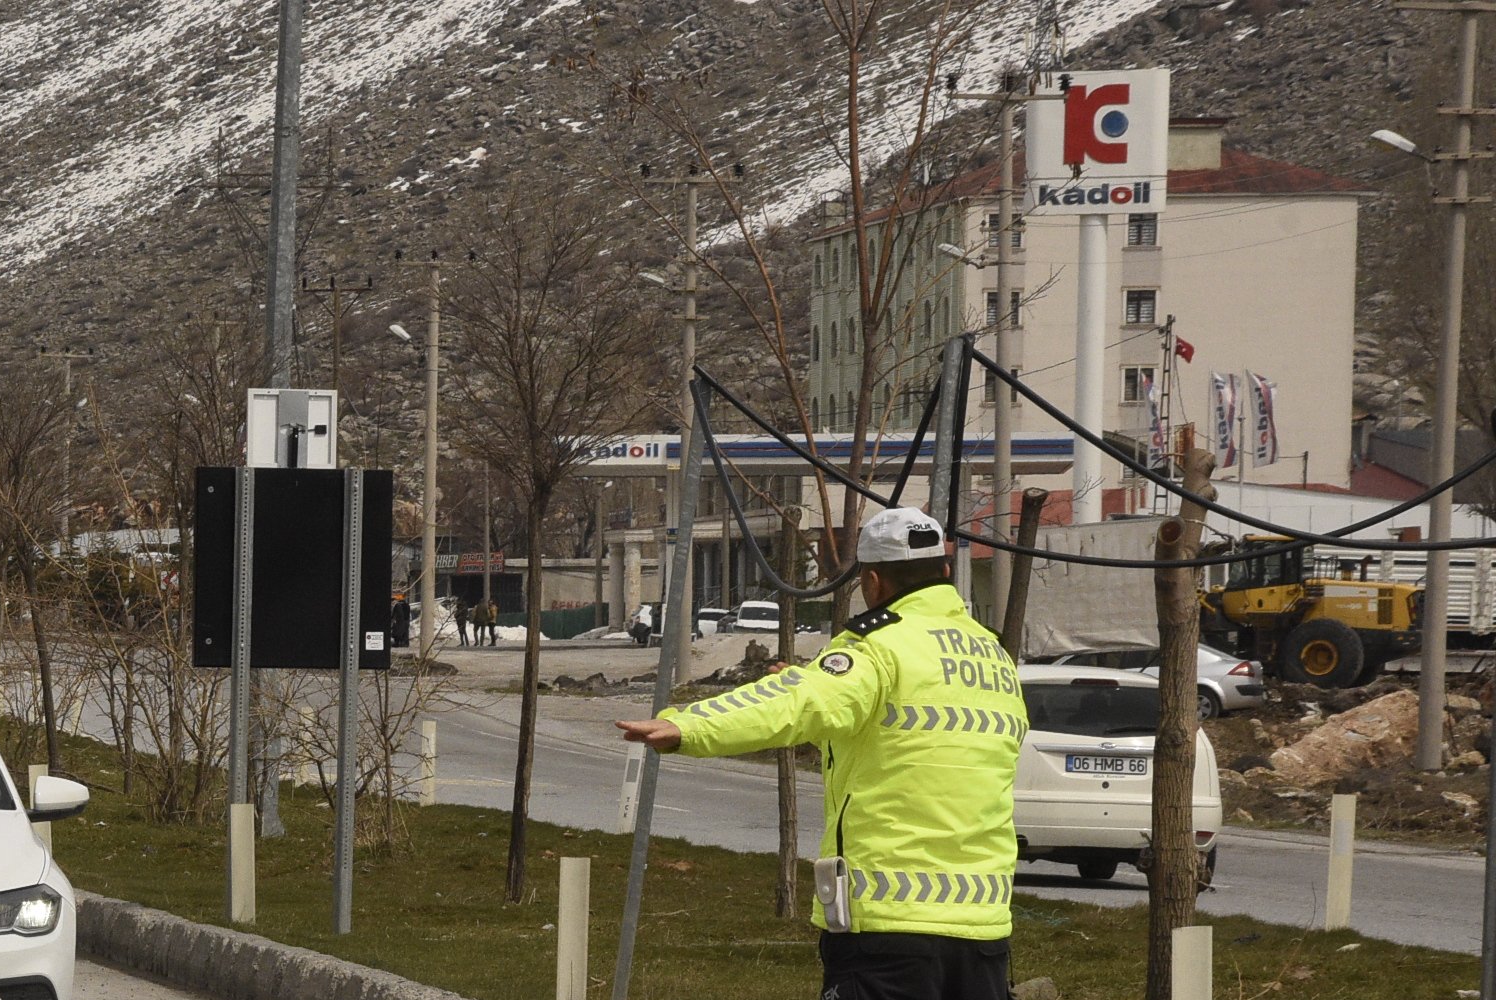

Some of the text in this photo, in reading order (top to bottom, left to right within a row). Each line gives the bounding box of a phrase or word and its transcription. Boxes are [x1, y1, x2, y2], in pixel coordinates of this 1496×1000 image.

[1038, 182, 1151, 206] kadoil
[435, 554, 459, 568] HBER
[1073, 757, 1090, 771] 06
[1093, 758, 1124, 771] HMB
[1129, 759, 1145, 773] 66
